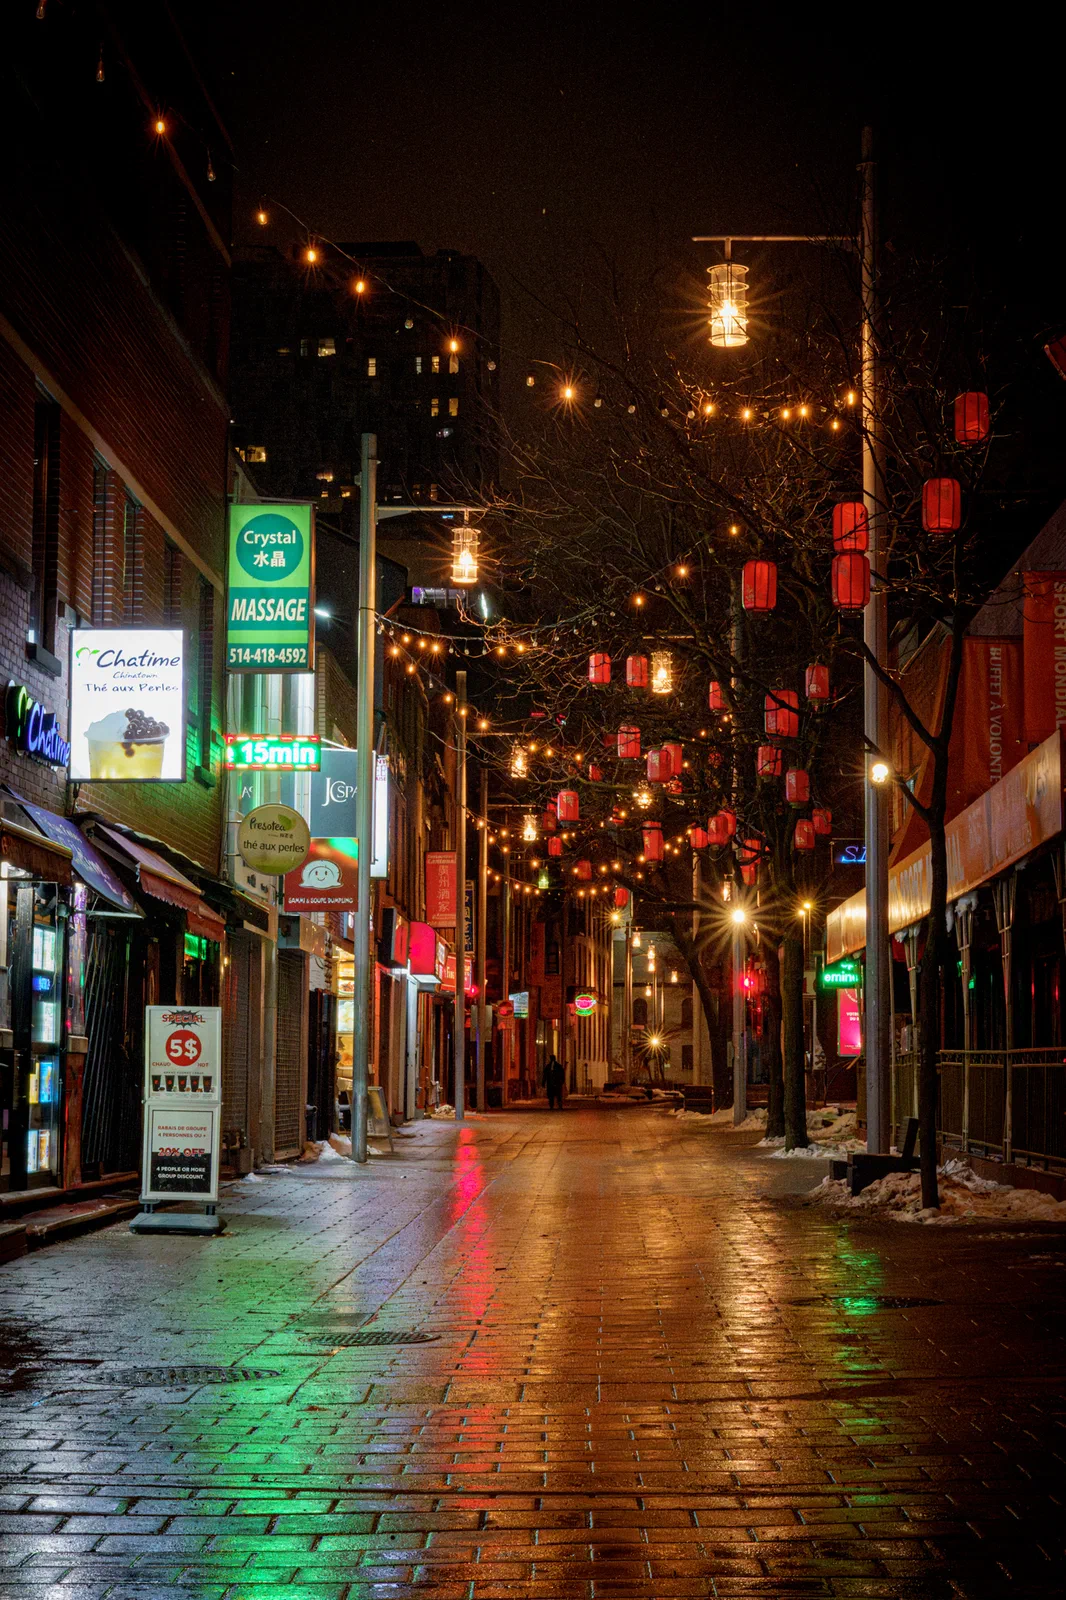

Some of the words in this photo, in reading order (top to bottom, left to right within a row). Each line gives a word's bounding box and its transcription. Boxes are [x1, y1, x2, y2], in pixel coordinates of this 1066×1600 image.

[244, 530, 296, 547] Crystal
[254, 551, 286, 567] 水晶
[231, 598, 306, 621] MASSAGE
[97, 649, 180, 668] Chatime
[230, 648, 306, 663] 514-418-4592
[112, 671, 158, 679] Chinatown
[990, 647, 1002, 697] BUFFET
[85, 683, 107, 692] Thé
[112, 684, 134, 692] aux
[139, 684, 178, 692] Perles
[28, 702, 71, 767] Chatime
[242, 742, 316, 764] 15min
[250, 816, 286, 832] Presotea
[243, 840, 258, 850] thé
[260, 843, 276, 851] aux
[278, 843, 305, 853] perles
[161, 1013, 206, 1023] SPECIAL
[170, 1038, 198, 1060] 5$
[158, 1147, 181, 1157] 20%
[184, 1148, 205, 1157] OFF
